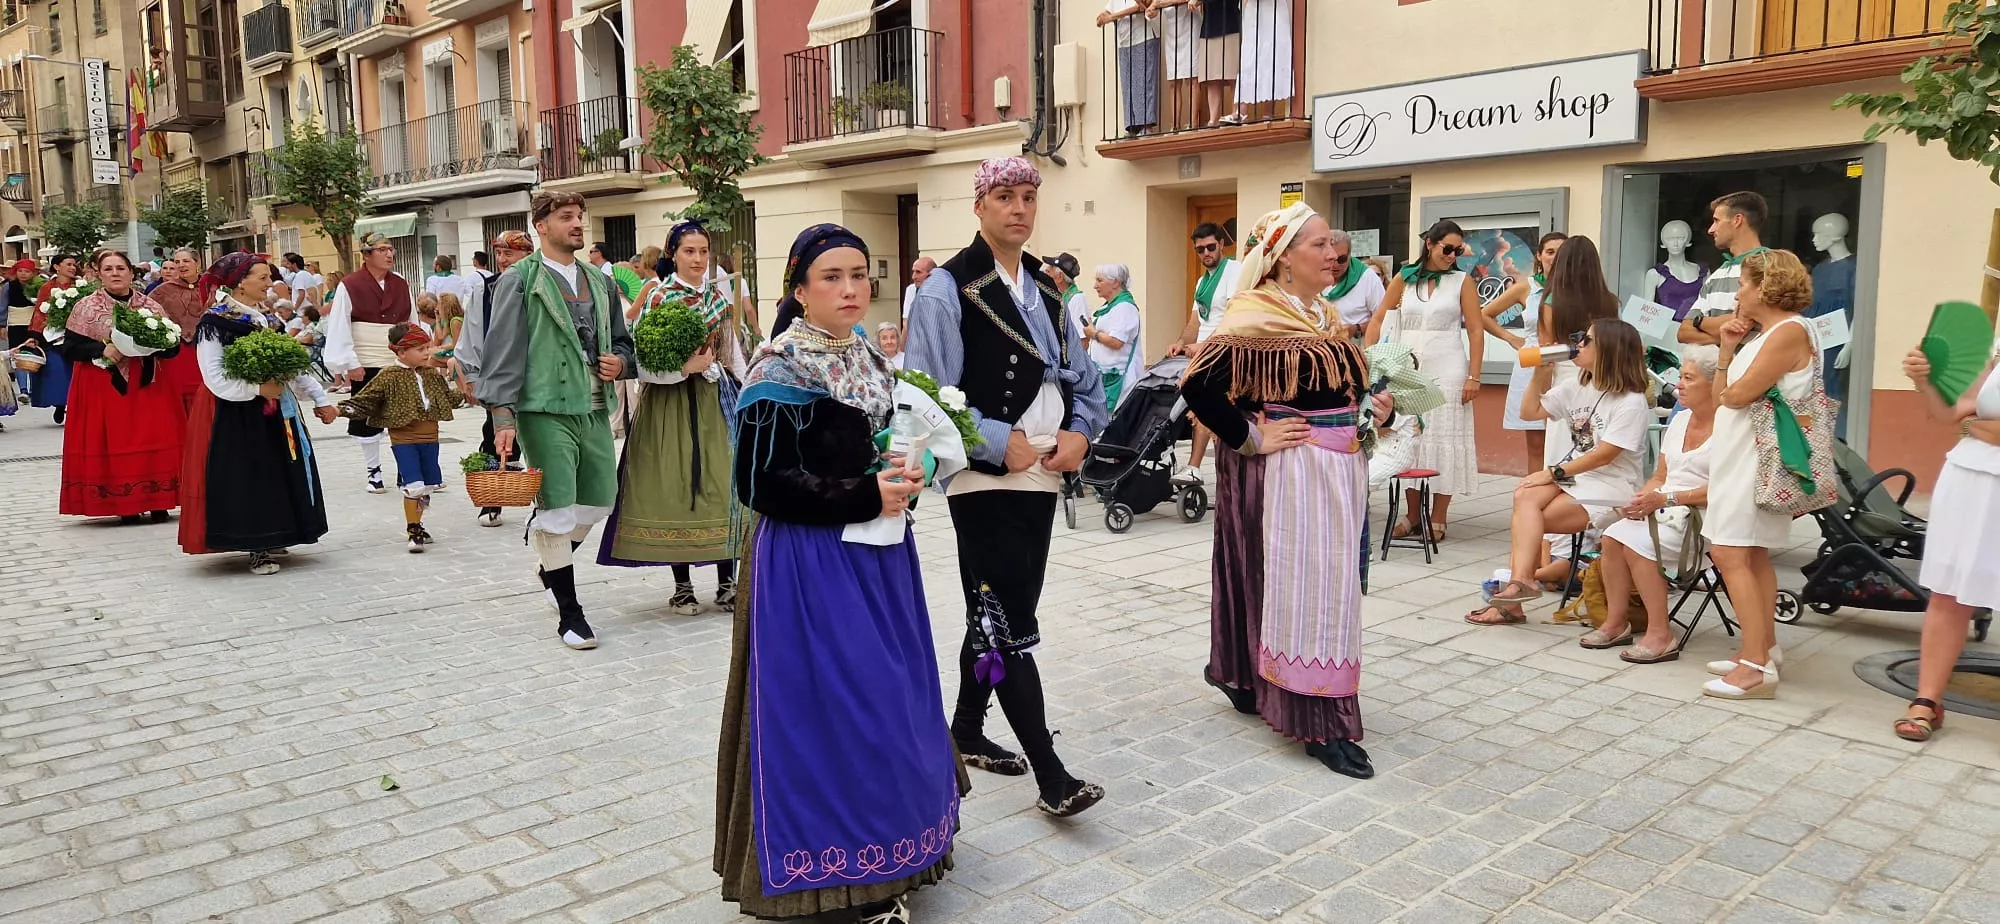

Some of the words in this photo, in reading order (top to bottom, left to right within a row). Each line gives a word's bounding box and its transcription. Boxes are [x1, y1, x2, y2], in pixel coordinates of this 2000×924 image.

[88, 61, 101, 102] Gastro
[1404, 94, 1522, 135] Dream
[1533, 76, 1615, 138] shop
[1324, 101, 1392, 160] D
